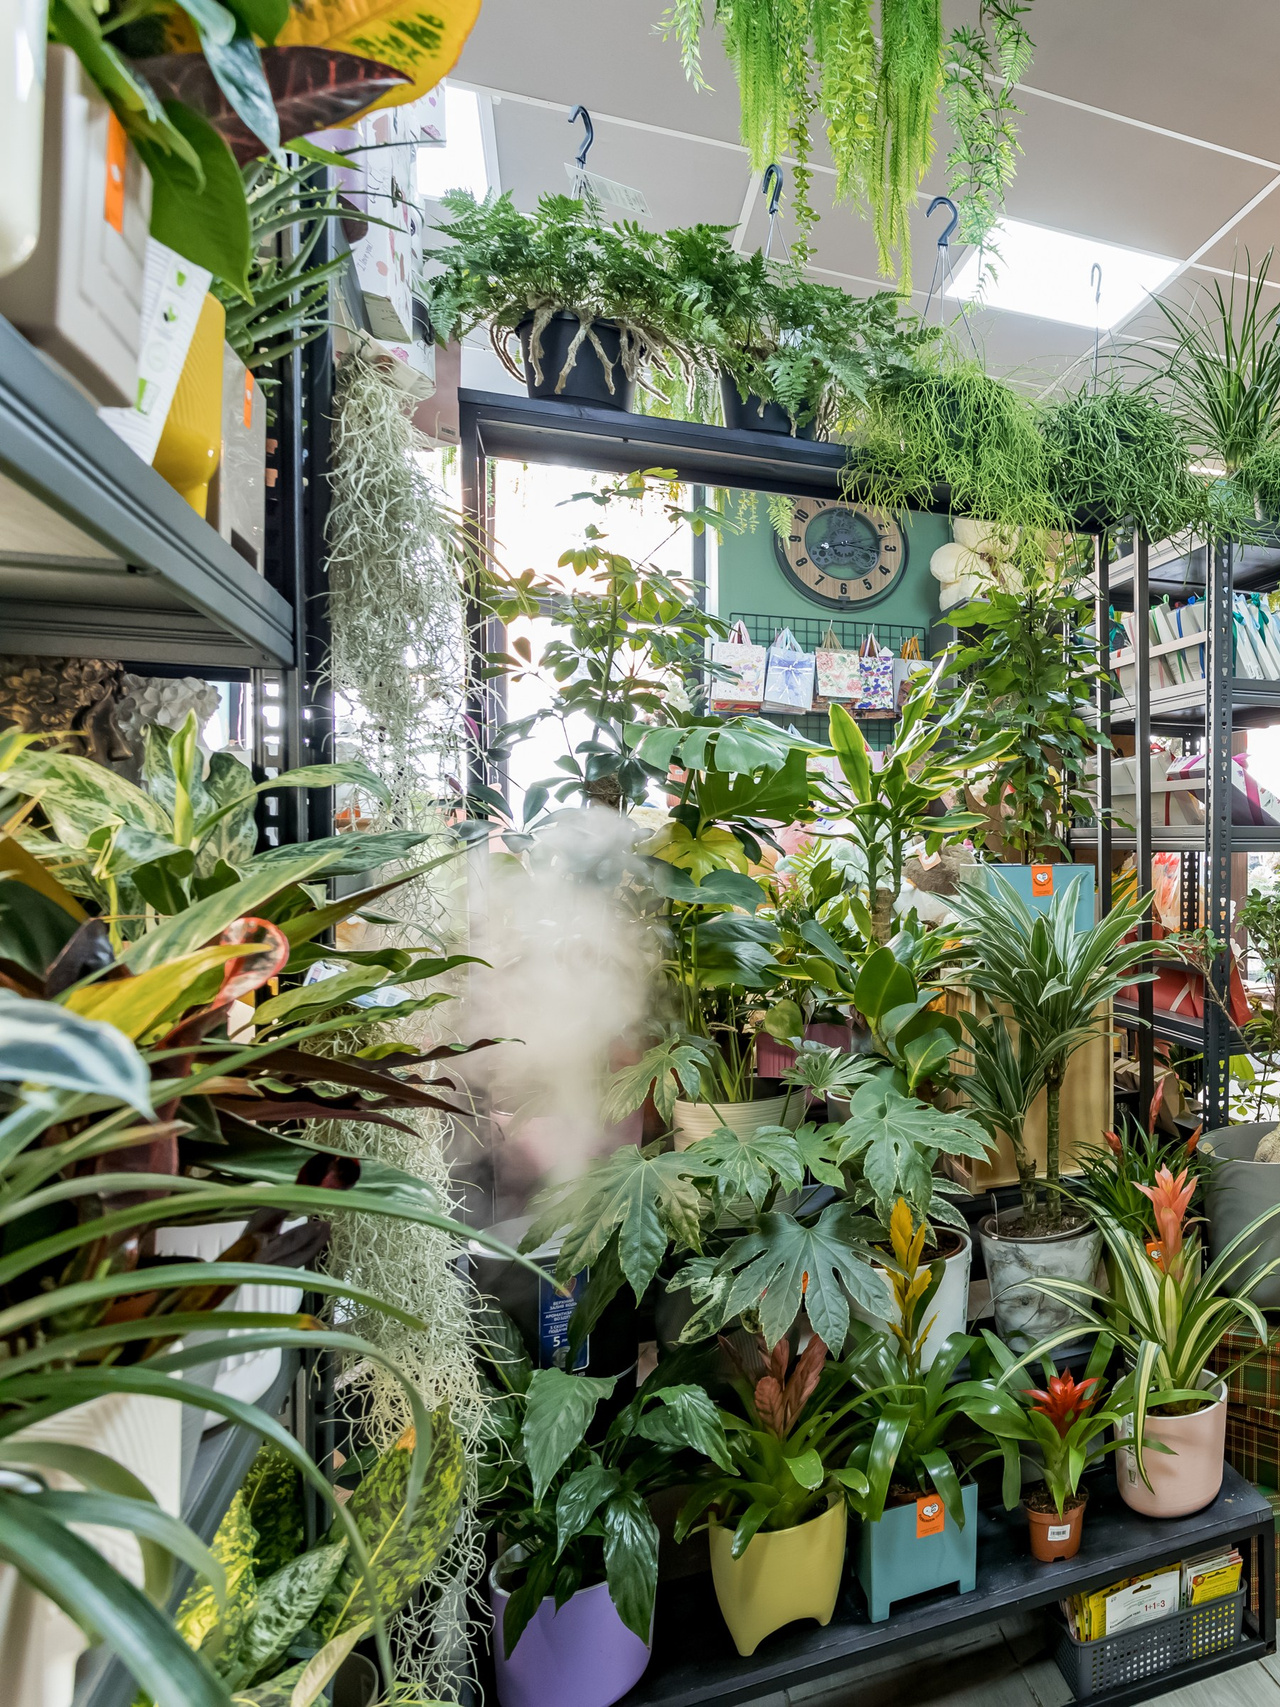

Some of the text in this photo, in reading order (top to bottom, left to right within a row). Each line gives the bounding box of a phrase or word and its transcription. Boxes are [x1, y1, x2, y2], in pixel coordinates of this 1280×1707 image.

[794, 509, 809, 523] 10
[795, 557, 808, 567] 8
[879, 565, 890, 575] 4
[814, 575, 825, 585] 7
[862, 579, 872, 590] 5
[840, 583, 847, 594] 6
[553, 1336, 561, 1347] 5
